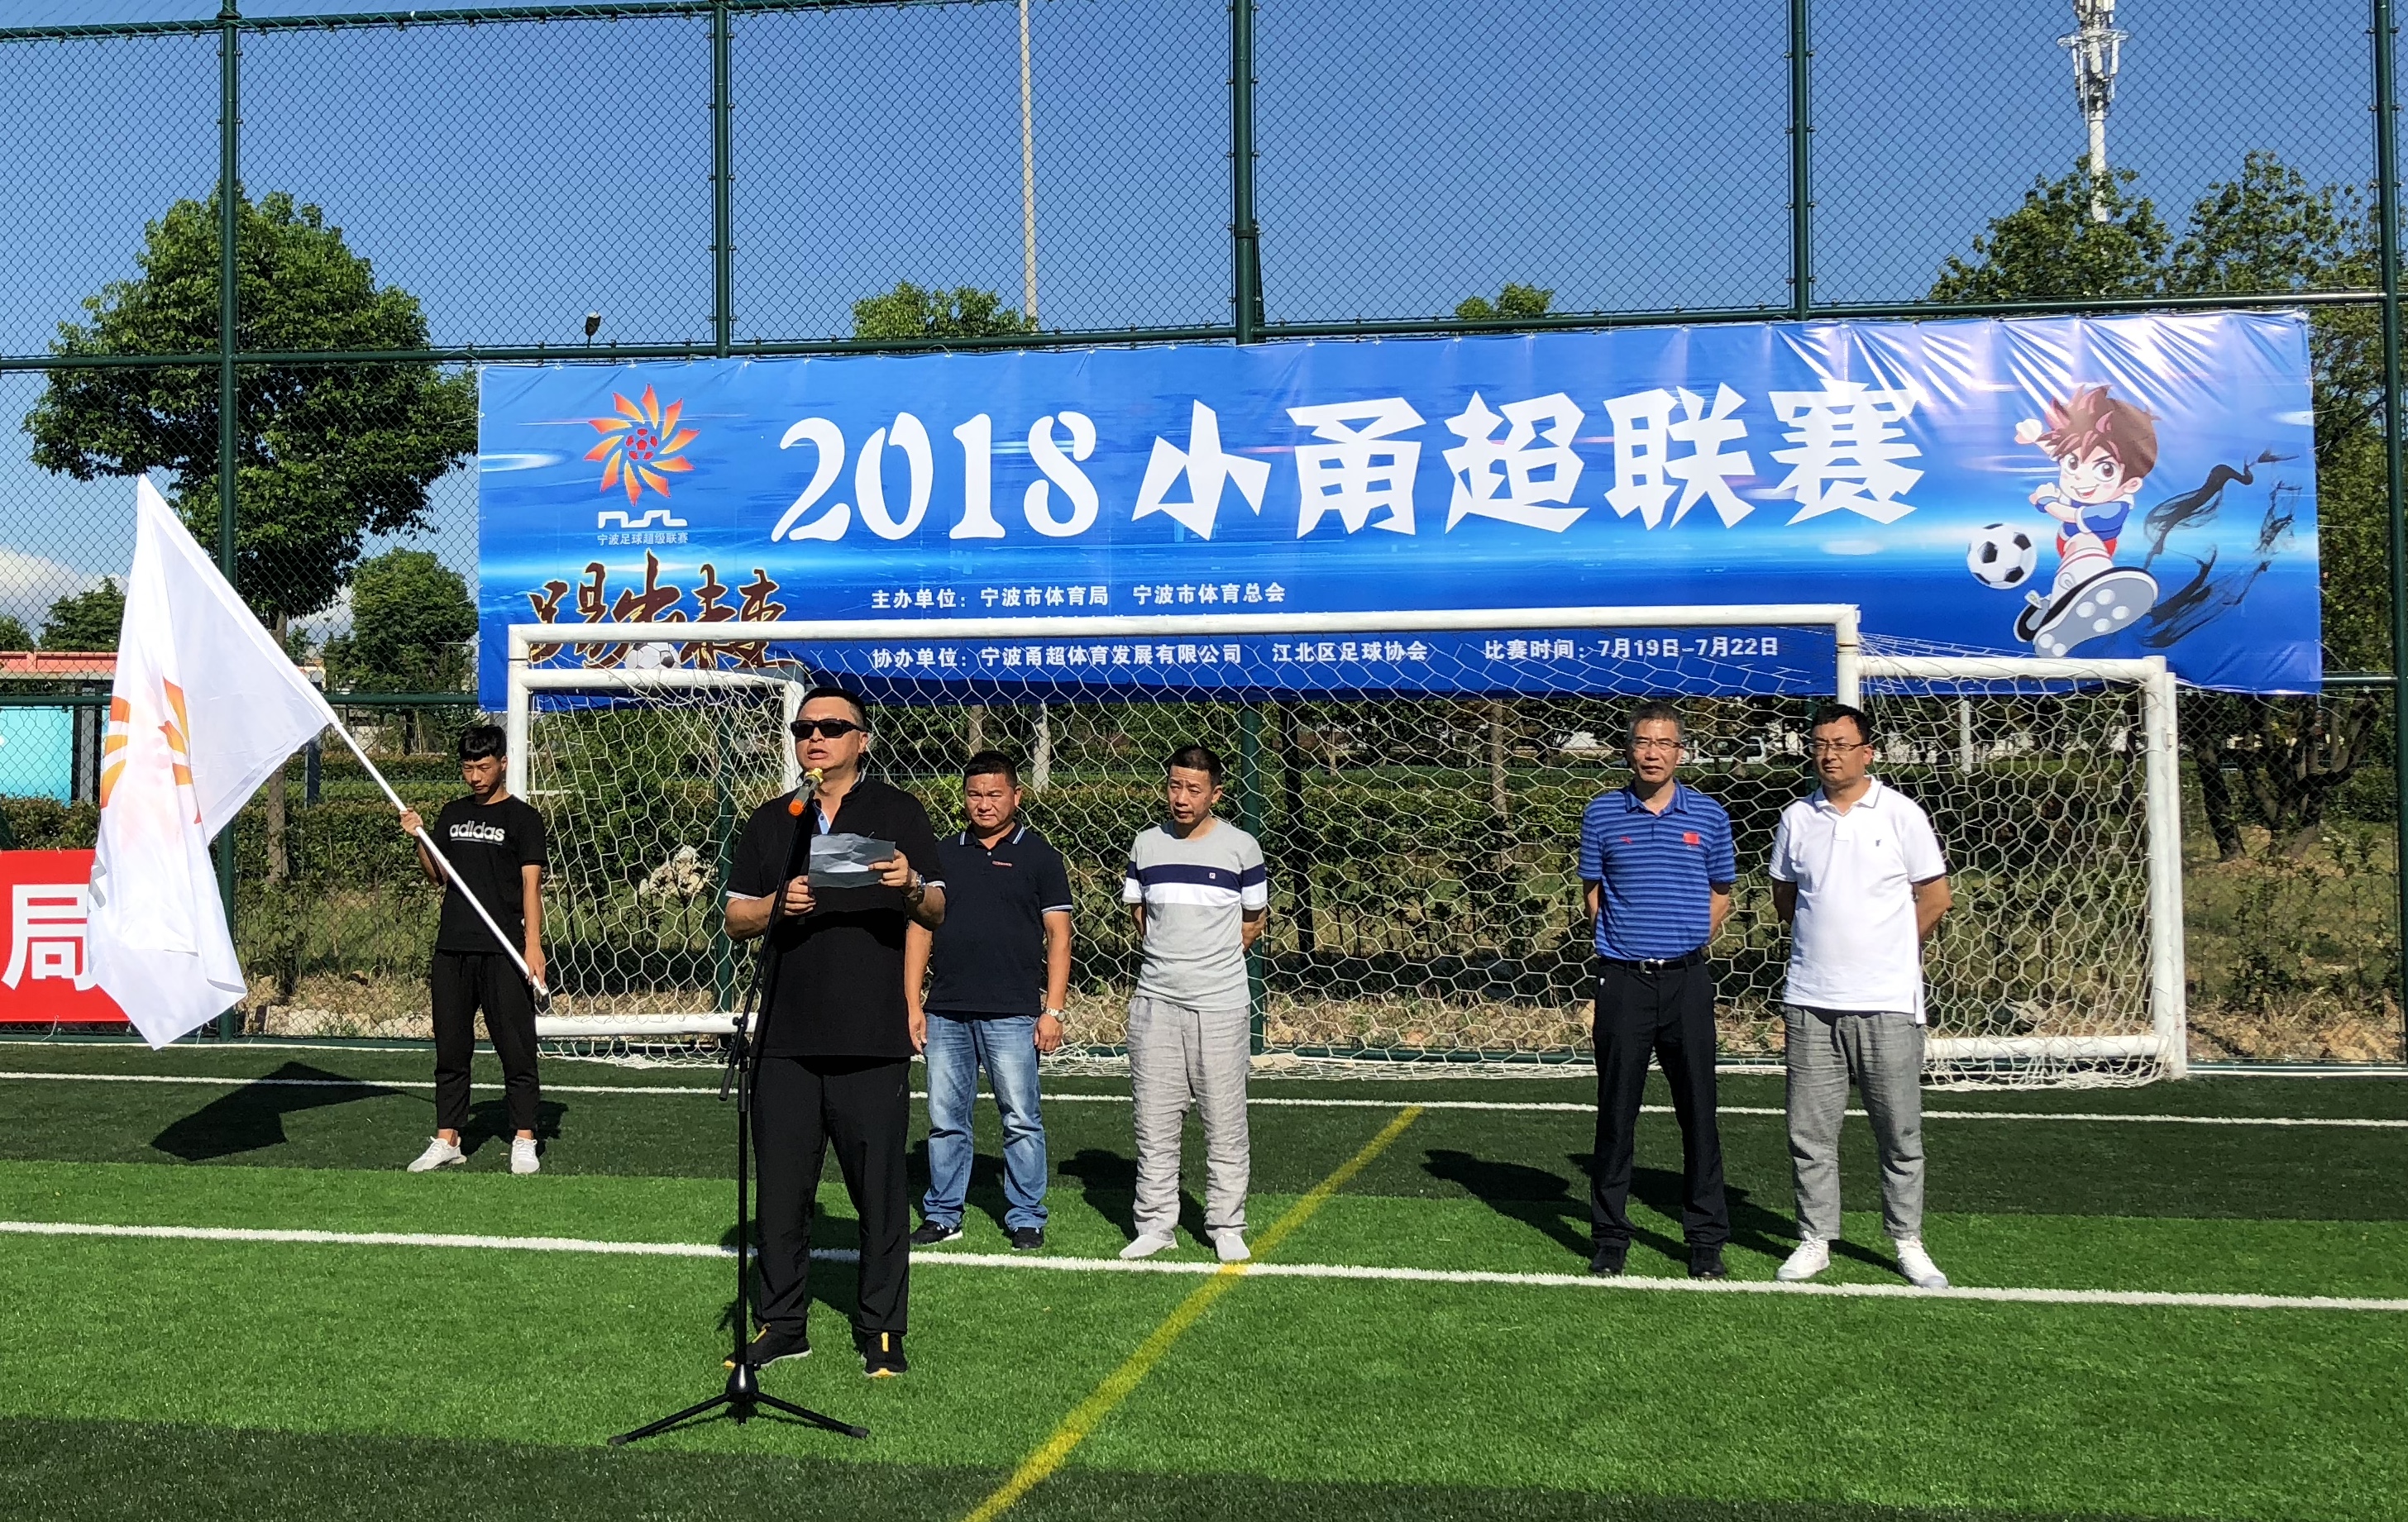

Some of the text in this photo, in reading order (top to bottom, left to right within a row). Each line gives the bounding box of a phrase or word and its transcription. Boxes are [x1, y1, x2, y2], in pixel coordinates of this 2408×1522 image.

[771, 379, 1925, 542] 2018 小甬超联赛
[597, 532, 689, 546] 宁波足球超级联赛
[1132, 581, 1286, 607] 宁波市体育总会
[1271, 640, 1428, 663] 江北区足球协会
[449, 819, 506, 842] adidas
[1, 883, 98, 992] 局
